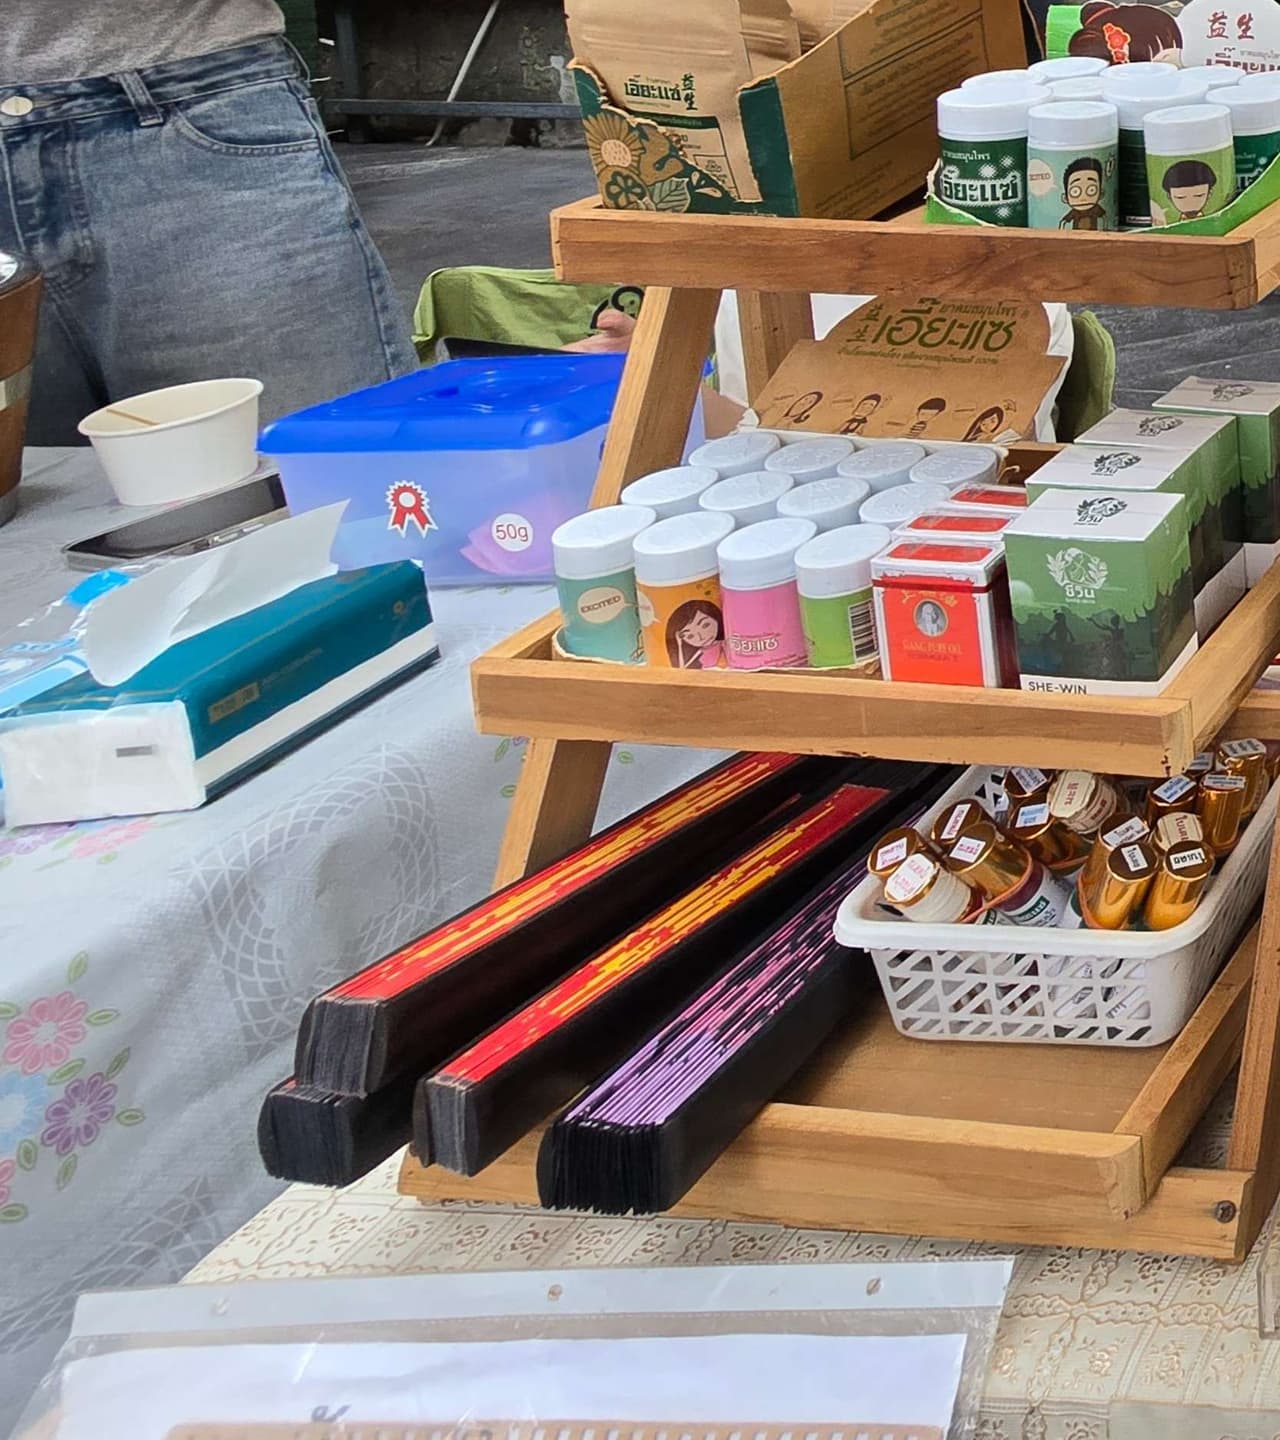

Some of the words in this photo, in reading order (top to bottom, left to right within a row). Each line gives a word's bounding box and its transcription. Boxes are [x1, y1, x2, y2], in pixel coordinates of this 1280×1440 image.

[494, 522, 531, 543] 50g
[580, 595, 622, 614] EXCITED
[1027, 681, 1088, 697] SHE-WIN
